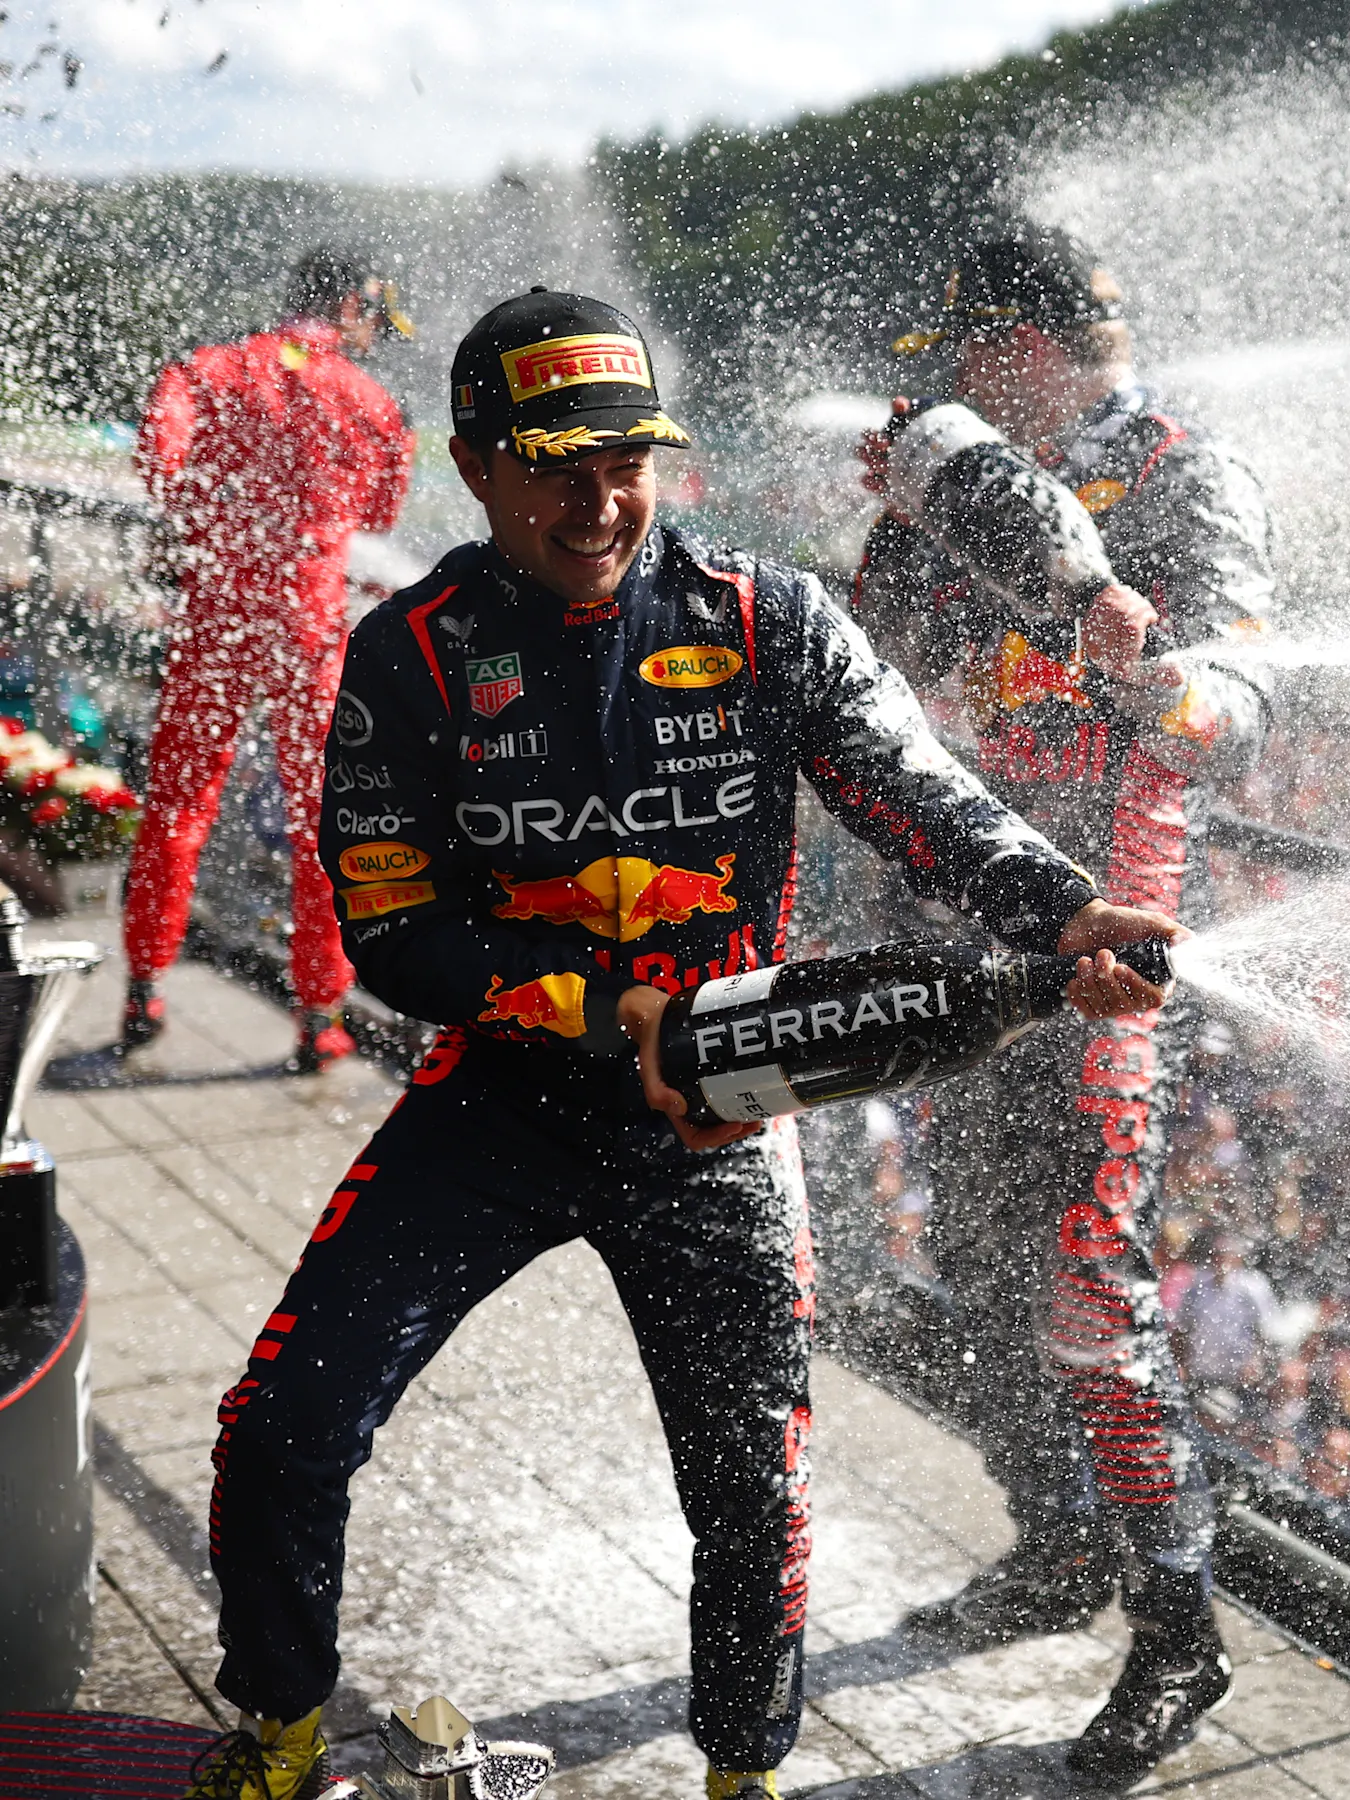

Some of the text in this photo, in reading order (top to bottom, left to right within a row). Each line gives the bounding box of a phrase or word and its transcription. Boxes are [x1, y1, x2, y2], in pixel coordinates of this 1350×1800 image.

[515, 342, 642, 390] PIRELLI
[563, 610, 592, 627] Red
[668, 655, 728, 677] RAUCH
[471, 679, 519, 713] EUER
[653, 705, 745, 745] BYBIT
[355, 763, 396, 791] Sui
[653, 749, 757, 775] HONDA
[336, 806, 401, 836] Claro
[454, 770, 757, 846] ORACLE
[356, 849, 419, 873] RAUCH
[350, 882, 425, 914] PIRELLI
[693, 978, 952, 1065] FERRARI
